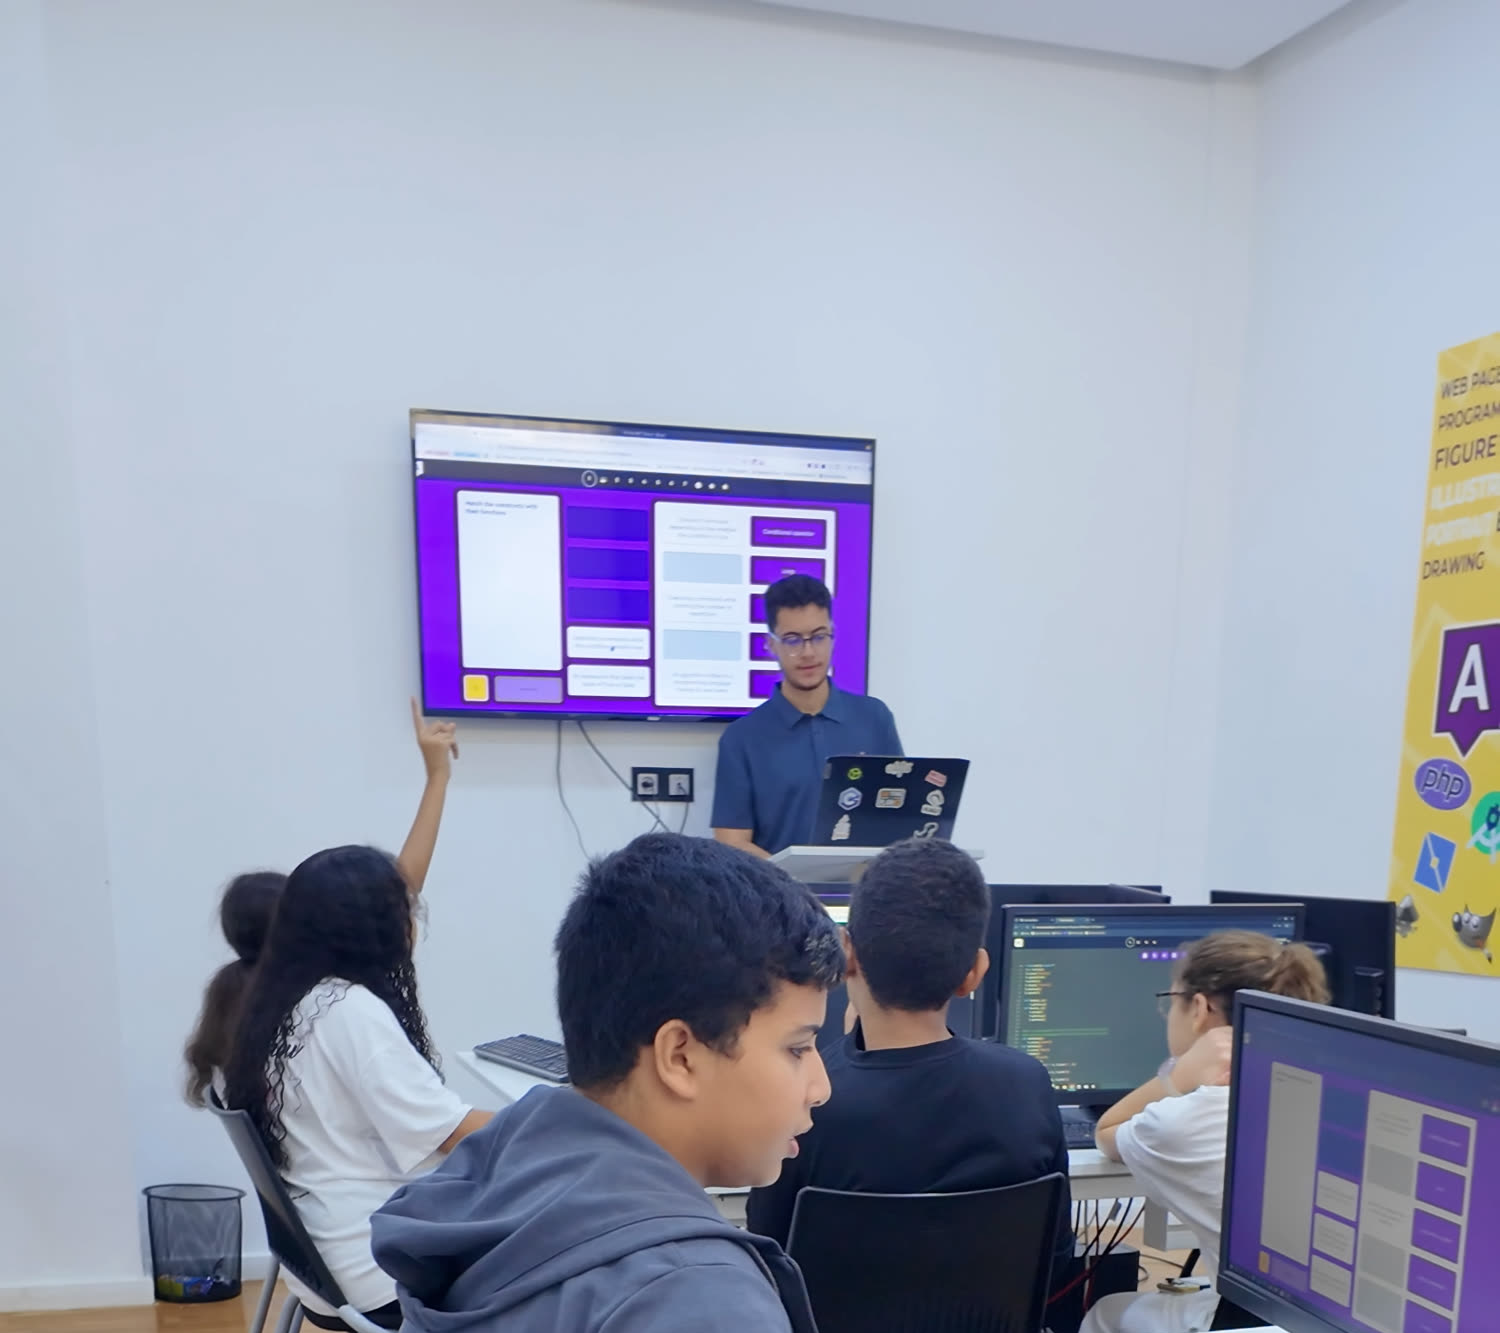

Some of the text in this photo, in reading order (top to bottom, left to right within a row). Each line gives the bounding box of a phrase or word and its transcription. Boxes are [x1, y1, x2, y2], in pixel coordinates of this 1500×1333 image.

[1441, 376, 1468, 400] WEB
[1434, 434, 1498, 471] FIGURE
[1422, 551, 1485, 580] DRAWING
[1447, 643, 1490, 713] A
[1420, 764, 1465, 802] php
